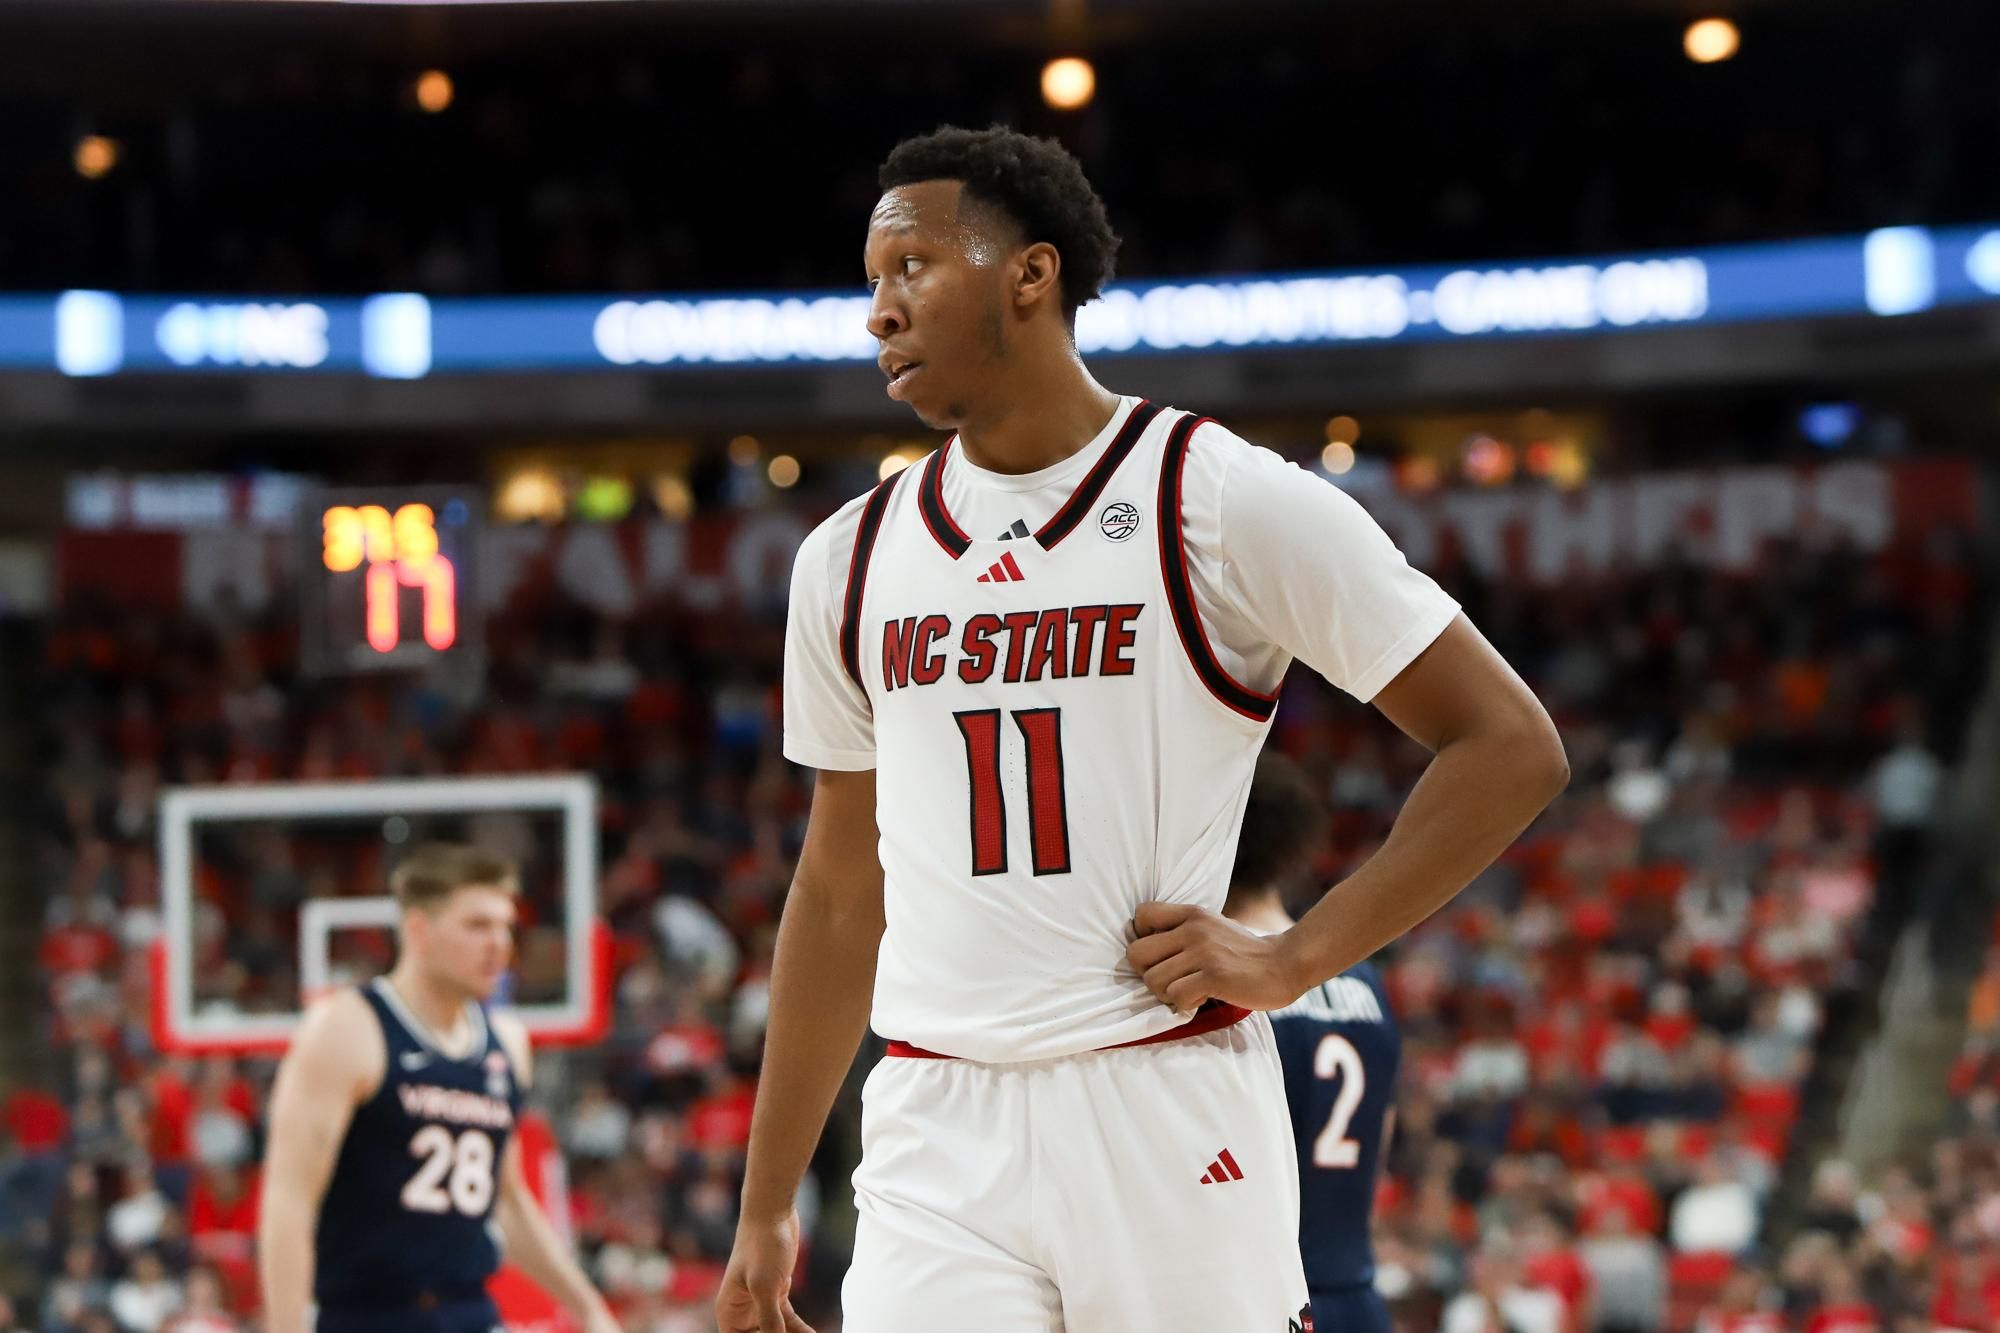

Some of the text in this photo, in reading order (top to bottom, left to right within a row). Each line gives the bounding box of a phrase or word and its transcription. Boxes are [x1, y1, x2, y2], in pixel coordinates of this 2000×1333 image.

[1105, 513, 1137, 523] ACC
[882, 603, 1145, 692] NC STATE
[952, 707, 1071, 876] 11
[1313, 1033, 1366, 1169] 2
[401, 1123, 494, 1218] 28
